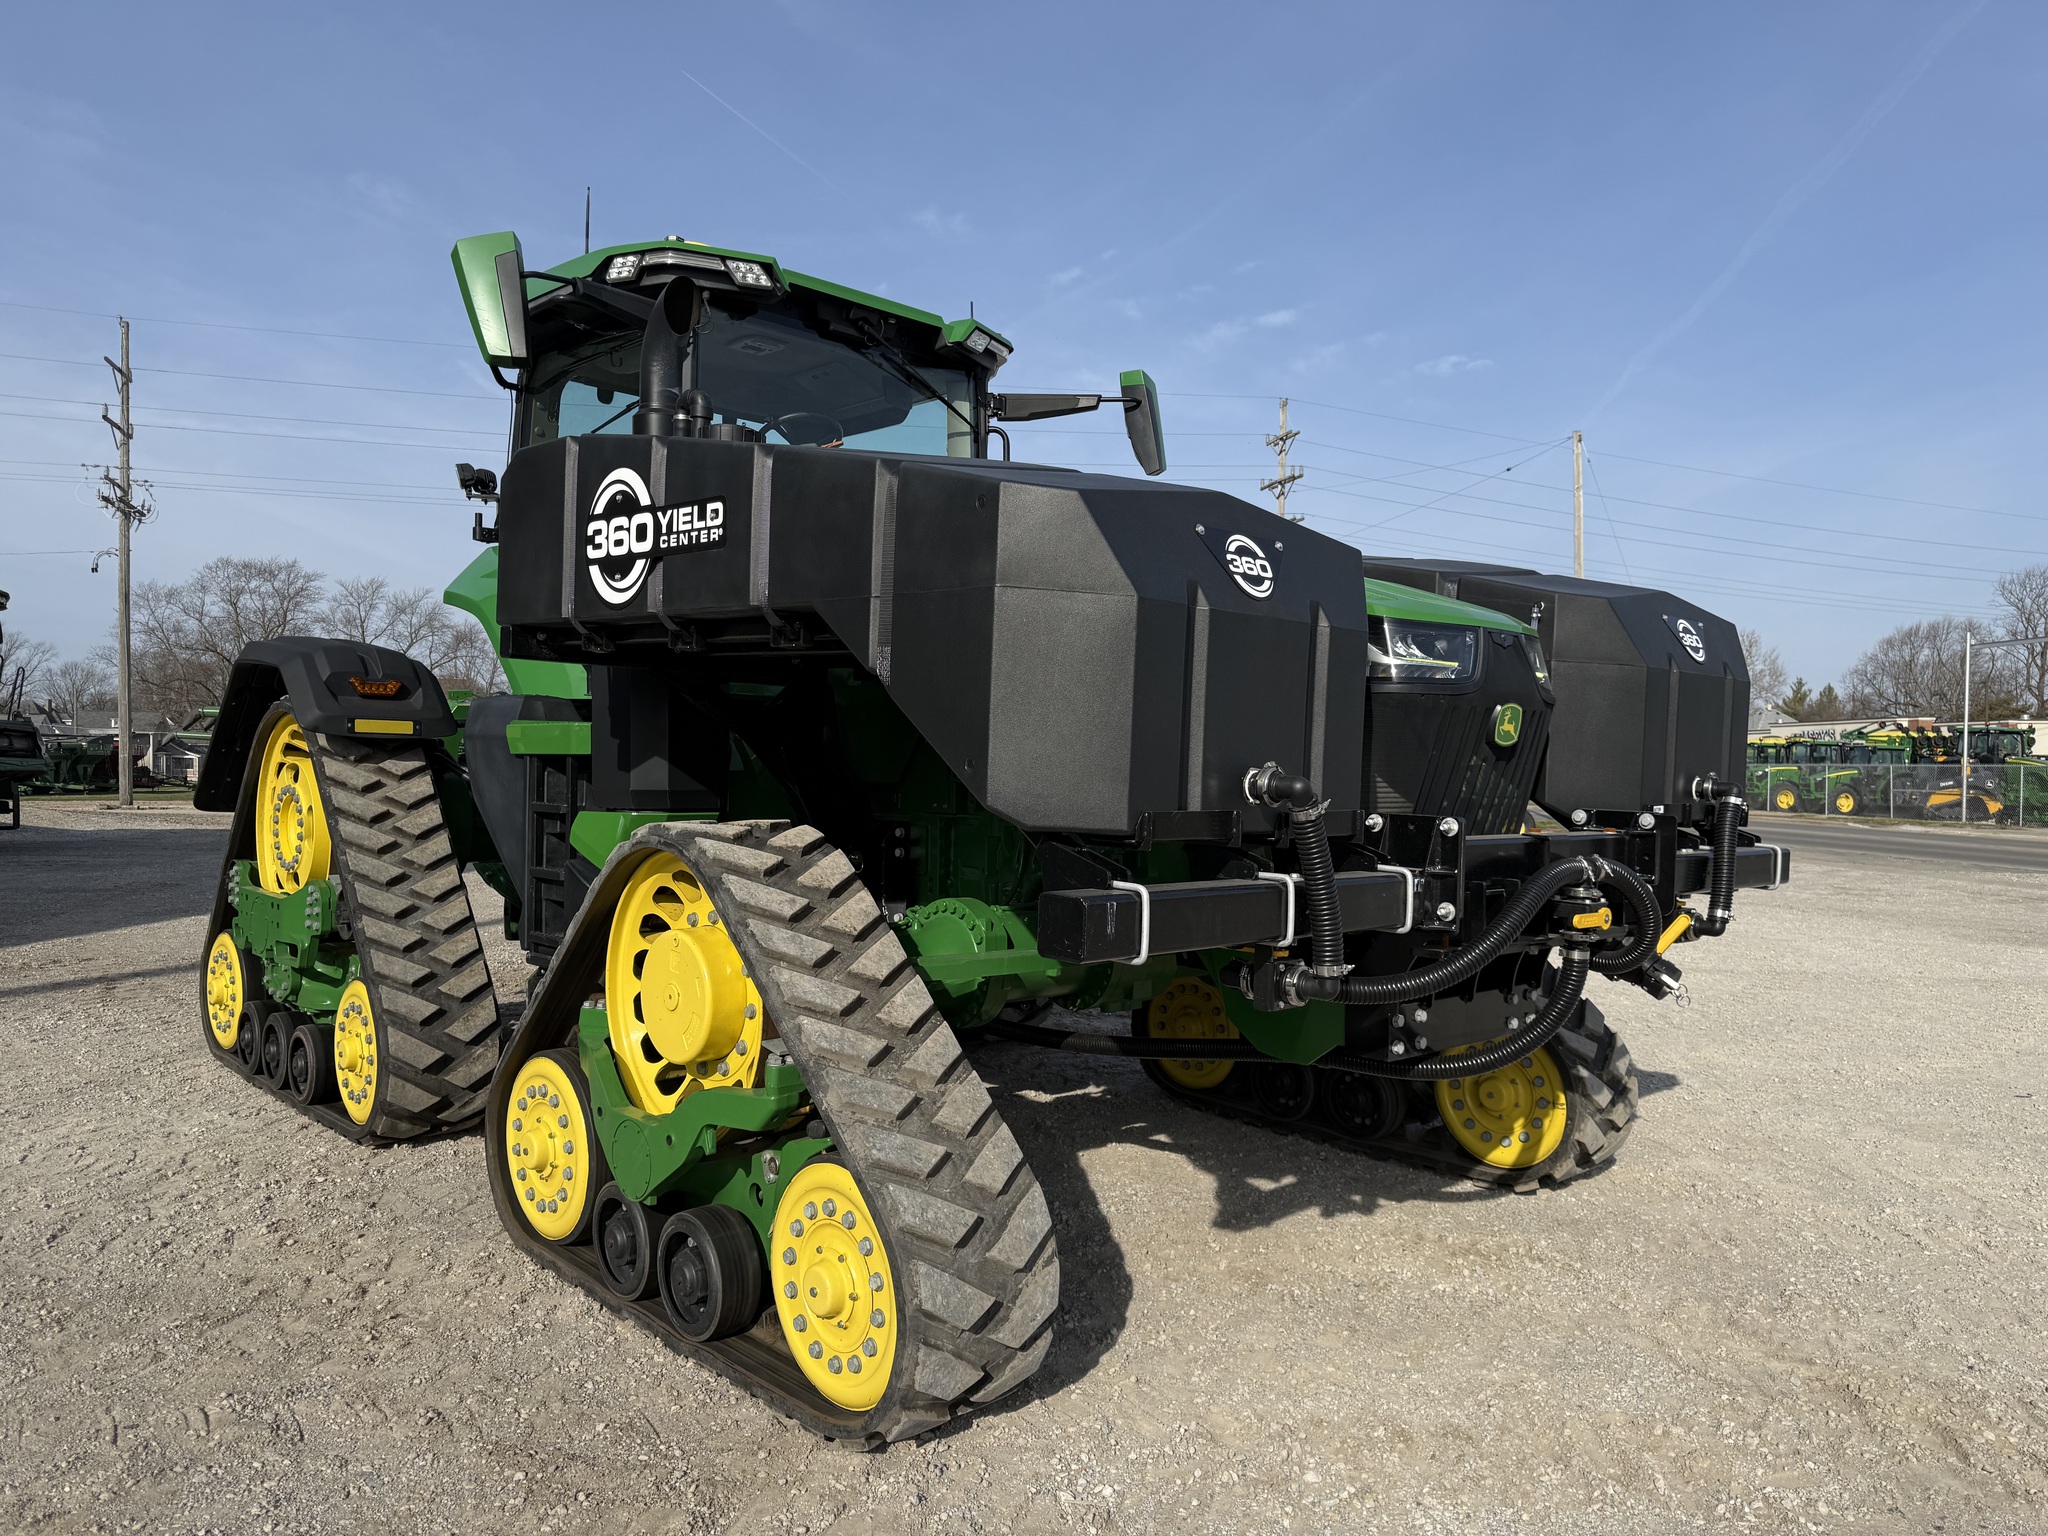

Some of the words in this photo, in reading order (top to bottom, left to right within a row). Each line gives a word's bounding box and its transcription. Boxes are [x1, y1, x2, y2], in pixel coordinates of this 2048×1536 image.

[586, 512, 654, 559] 360
[656, 501, 724, 534] YIELD
[1226, 553, 1273, 578] 360
[1679, 632, 1703, 648] 360
